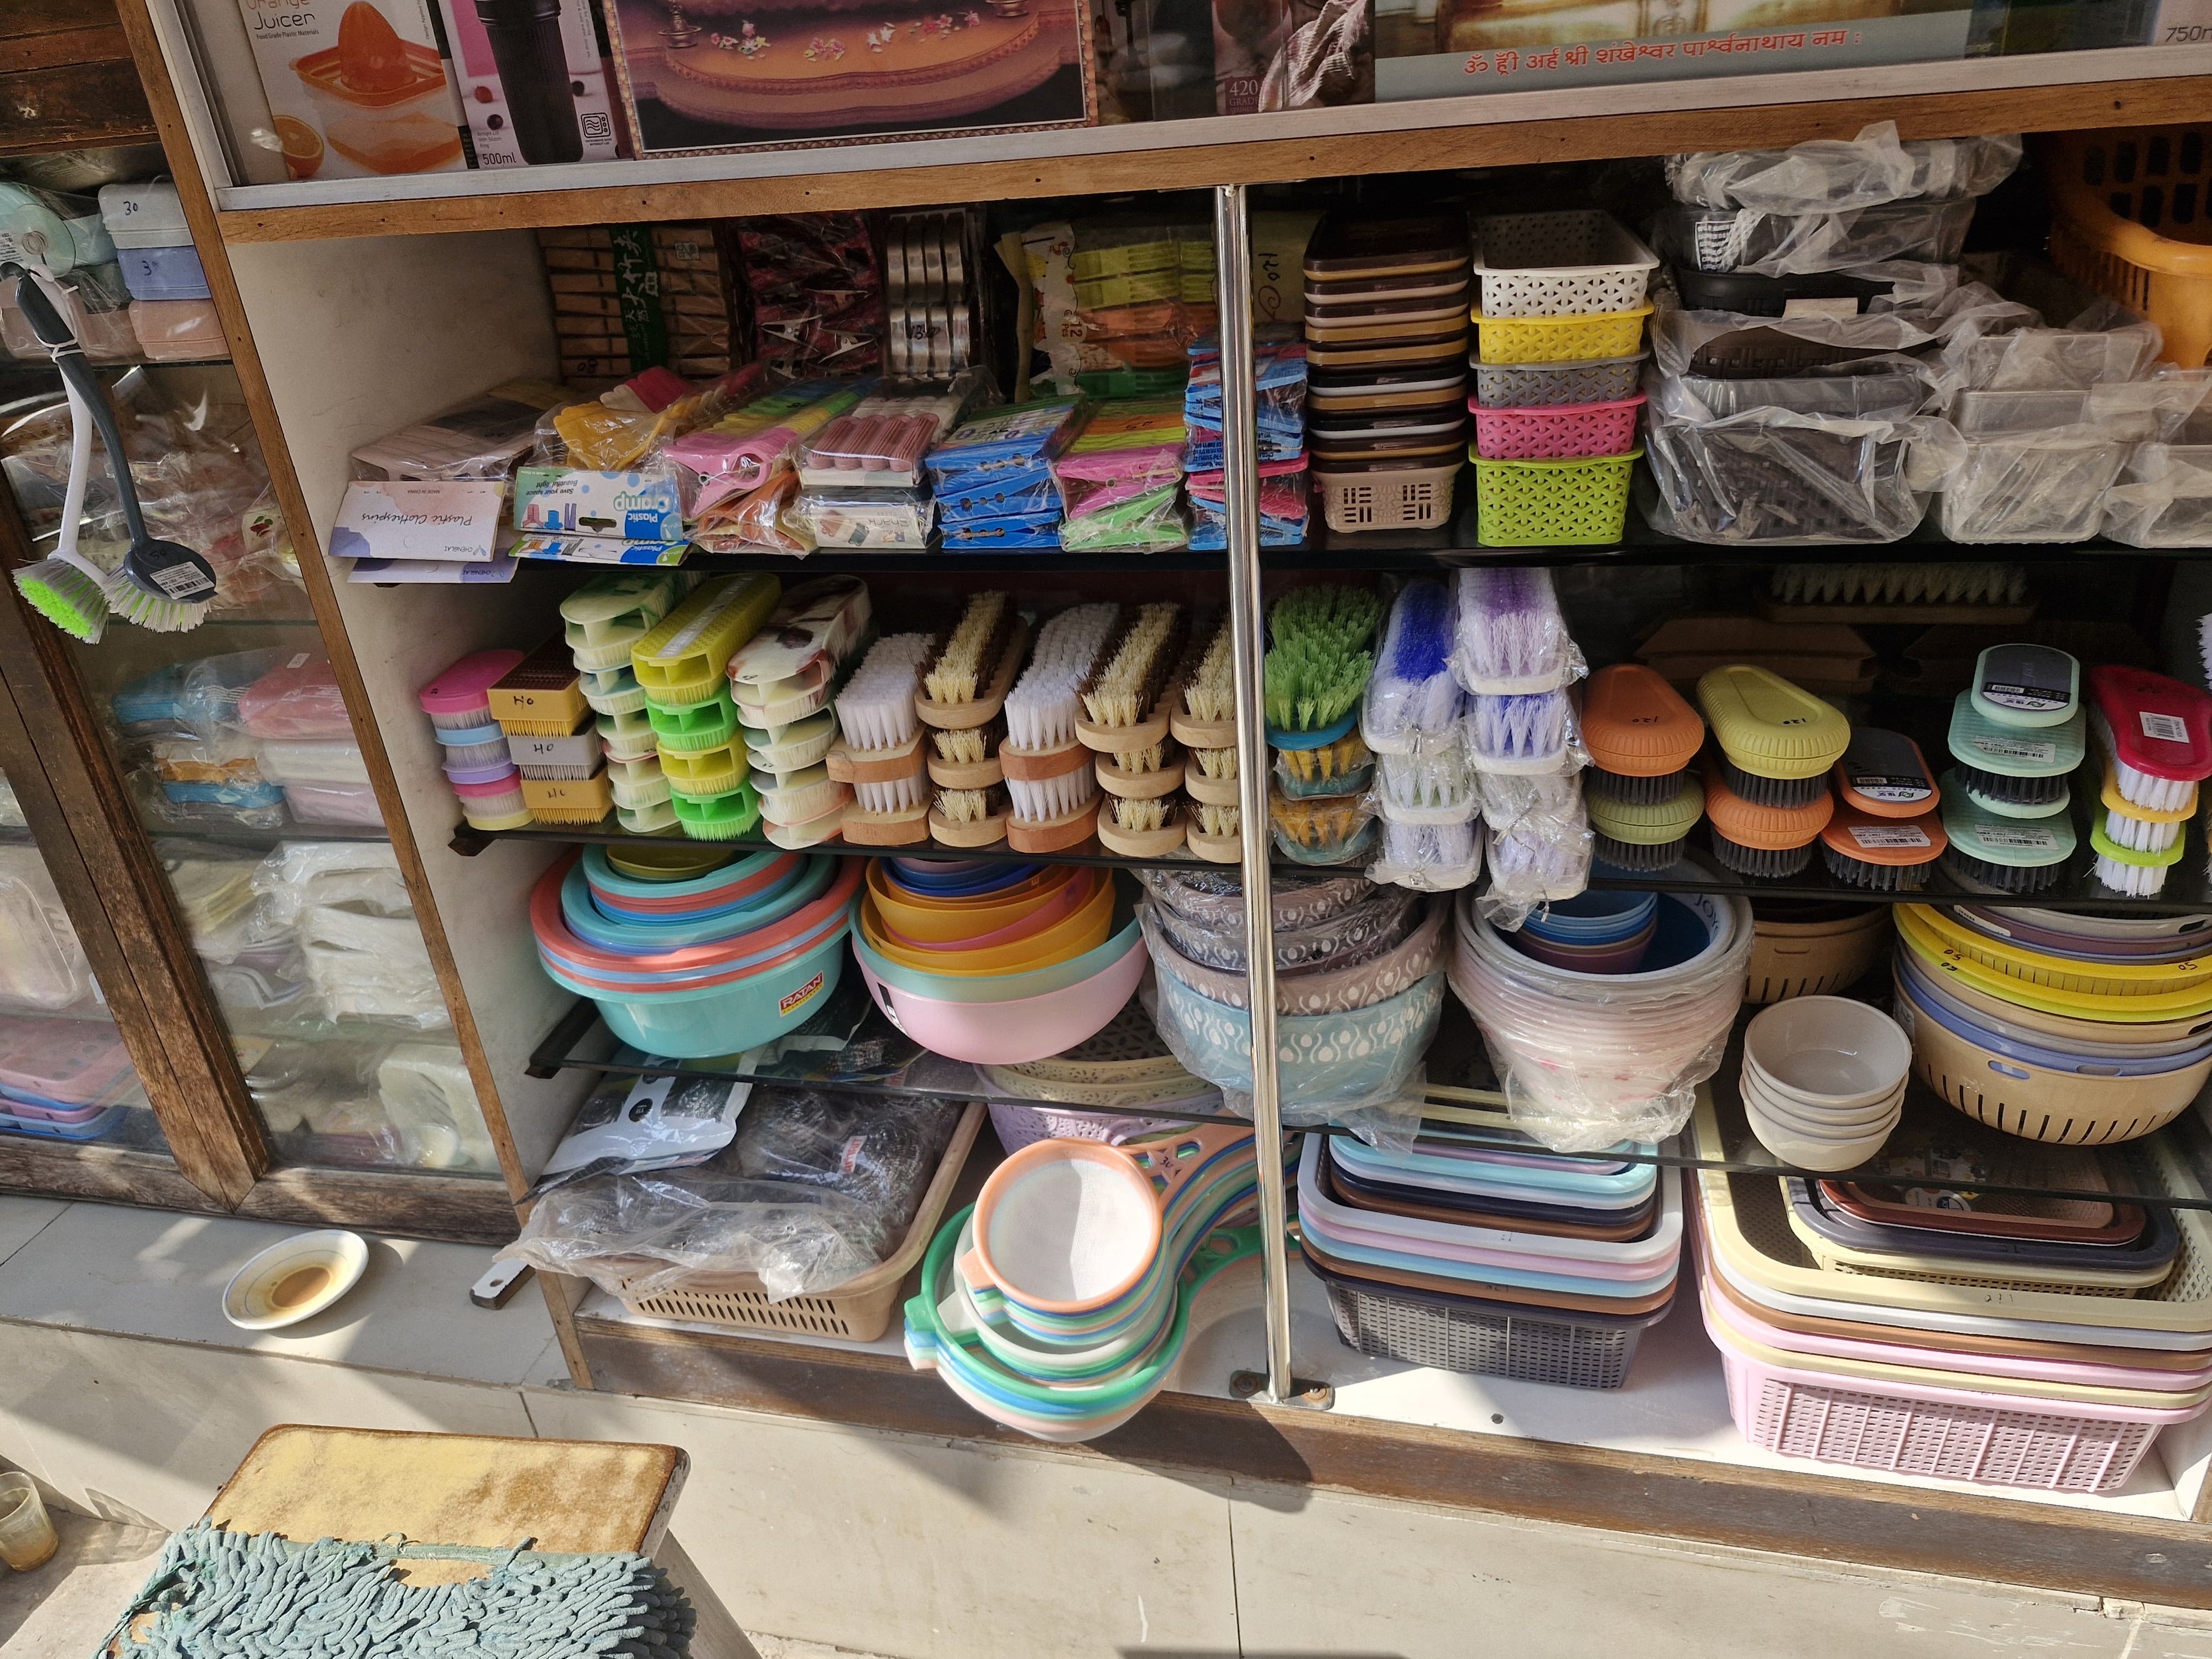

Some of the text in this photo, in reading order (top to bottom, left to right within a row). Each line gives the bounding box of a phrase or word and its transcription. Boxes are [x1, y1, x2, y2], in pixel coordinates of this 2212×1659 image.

[254, 12, 315, 30] Juicer
[1564, 44, 1589, 66] श्री
[1229, 79, 1258, 96] 420
[482, 153, 517, 165] 500ml
[123, 201, 138, 216] 30
[362, 512, 473, 526] Plastic Clothespins
[628, 512, 658, 523] Plastic
[868, 516, 910, 527] Shark
[782, 974, 823, 1009] RATAN
